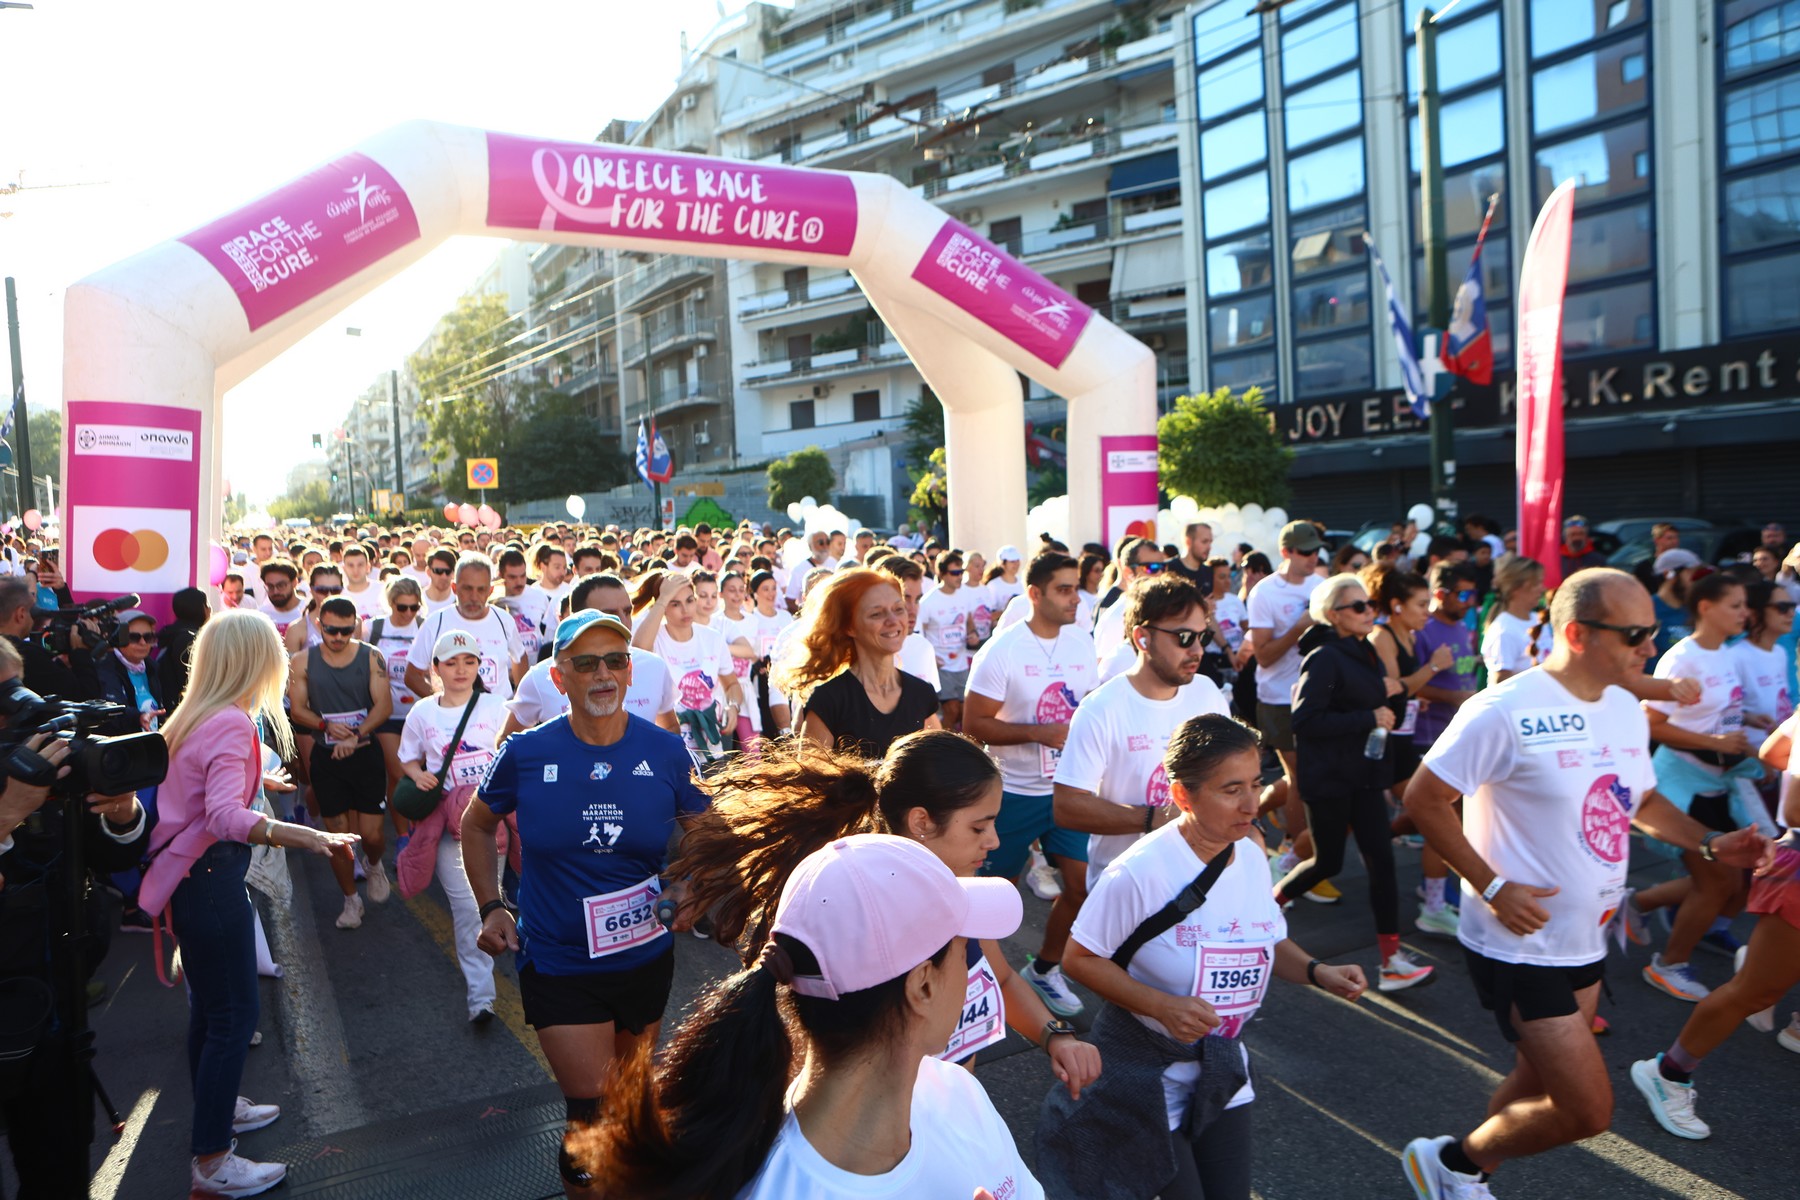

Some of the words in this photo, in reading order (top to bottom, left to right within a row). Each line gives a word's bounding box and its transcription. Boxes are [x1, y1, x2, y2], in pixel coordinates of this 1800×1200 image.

[695, 167, 768, 204] RACE
[609, 193, 665, 230] FOR
[675, 201, 724, 235] THE
[232, 215, 291, 254] RACE
[247, 238, 290, 270] FOR
[283, 219, 322, 249] THE
[959, 236, 1002, 269] RACE
[952, 246, 984, 273] FOR
[984, 266, 1012, 290] THE
[1288, 401, 1347, 440] JOY
[1520, 713, 1585, 736] SALFO
[632, 769, 654, 777] adidas
[605, 904, 653, 932] 6632
[1210, 967, 1261, 989] 13963
